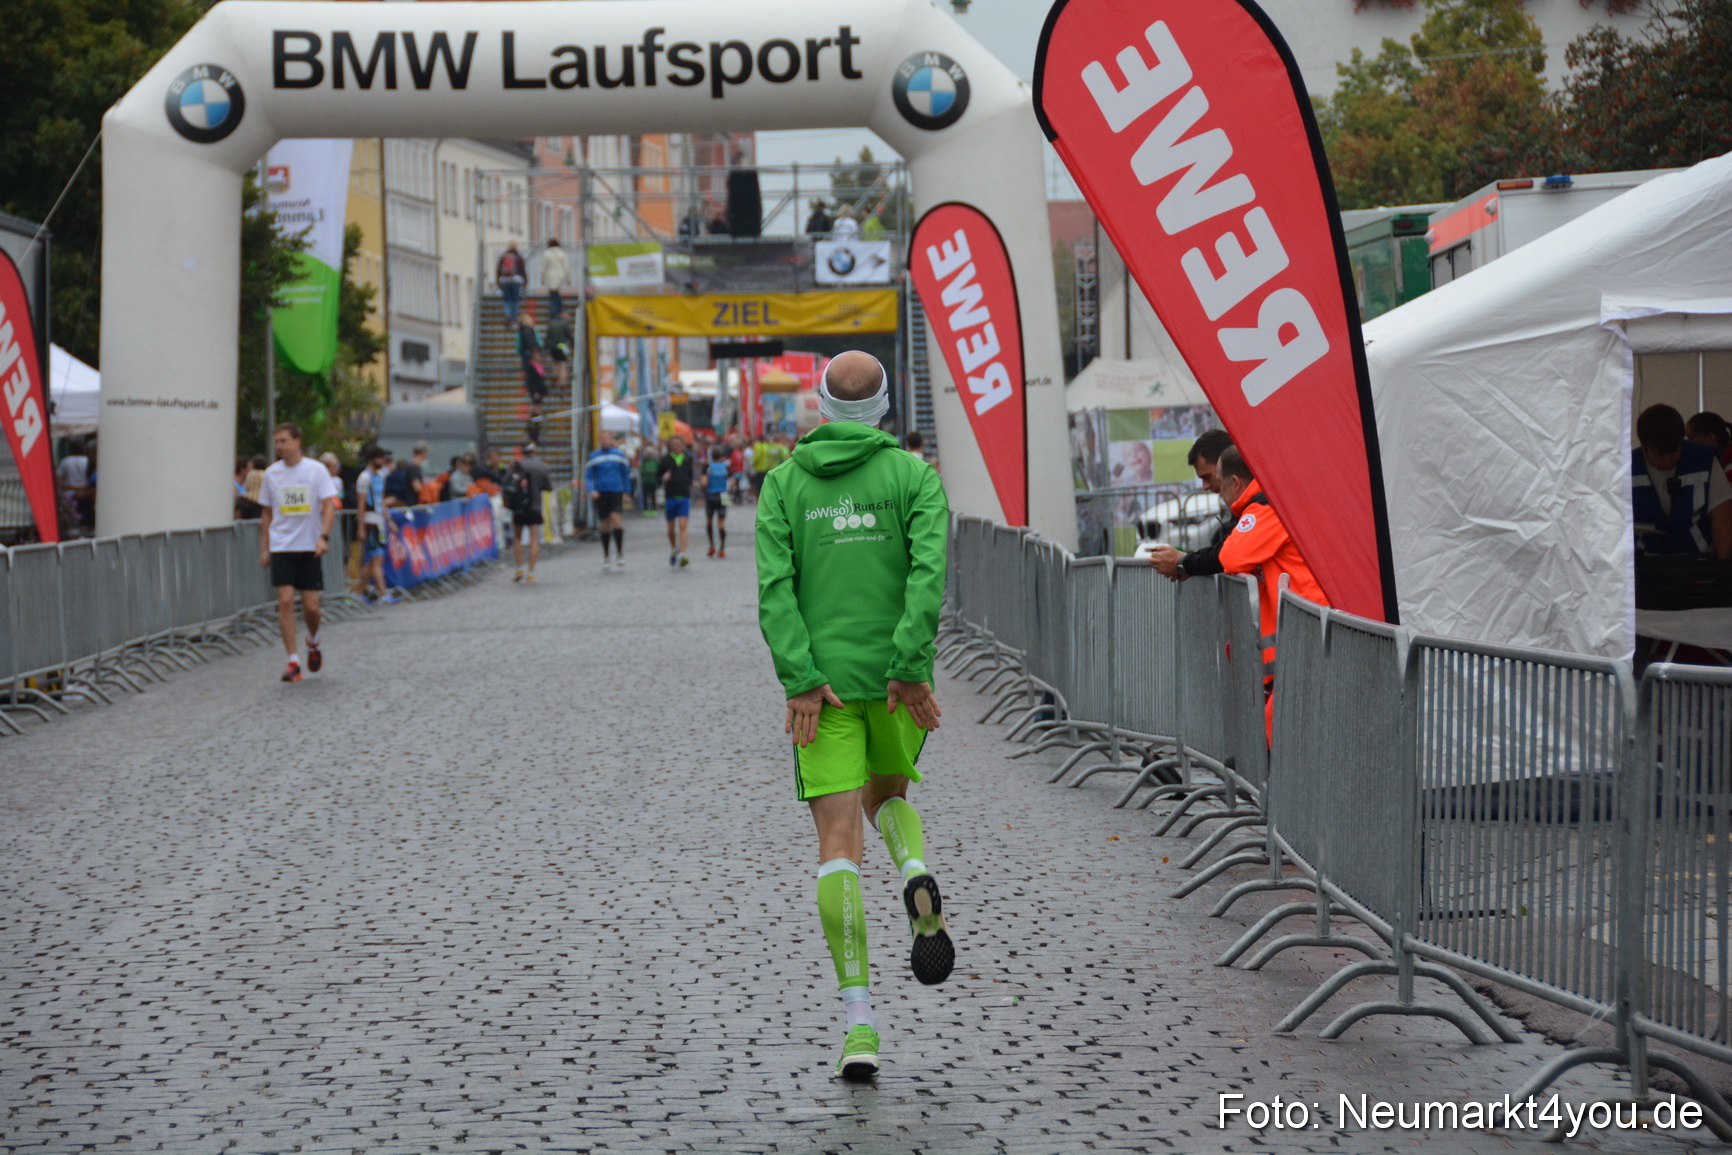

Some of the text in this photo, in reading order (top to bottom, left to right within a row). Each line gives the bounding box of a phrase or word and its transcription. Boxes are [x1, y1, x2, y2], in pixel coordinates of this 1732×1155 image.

[273, 28, 863, 101] BMW Laufsport
[712, 302, 779, 326] ZIEL
[106, 396, 219, 411] www.bmw-laufsport.de
[805, 506, 846, 521] SoWiso
[854, 502, 875, 512] Run
